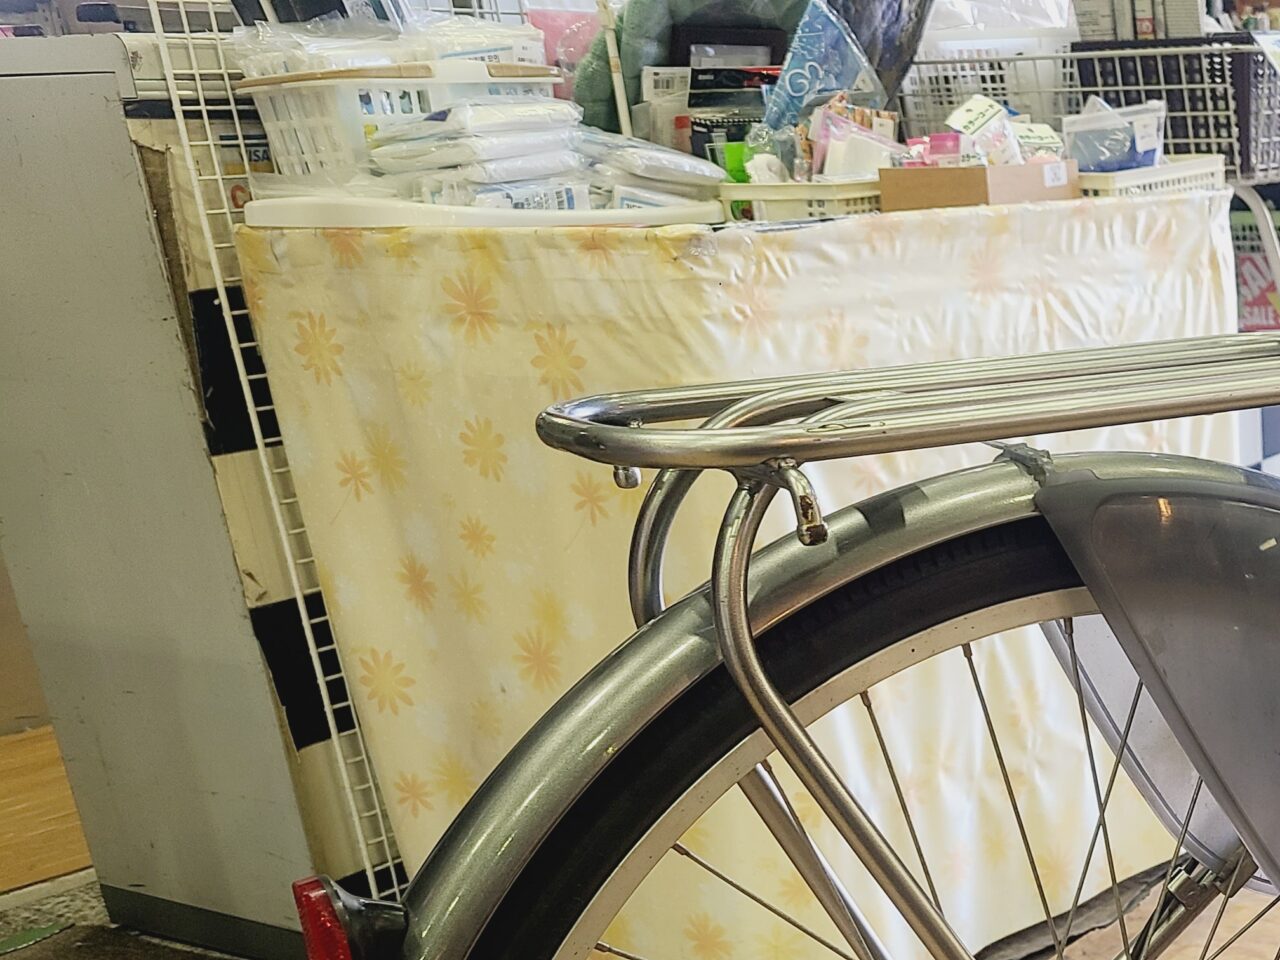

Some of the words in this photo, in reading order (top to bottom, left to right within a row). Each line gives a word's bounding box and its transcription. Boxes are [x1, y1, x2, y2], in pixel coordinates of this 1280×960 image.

[962, 104, 995, 131] カラーコード
